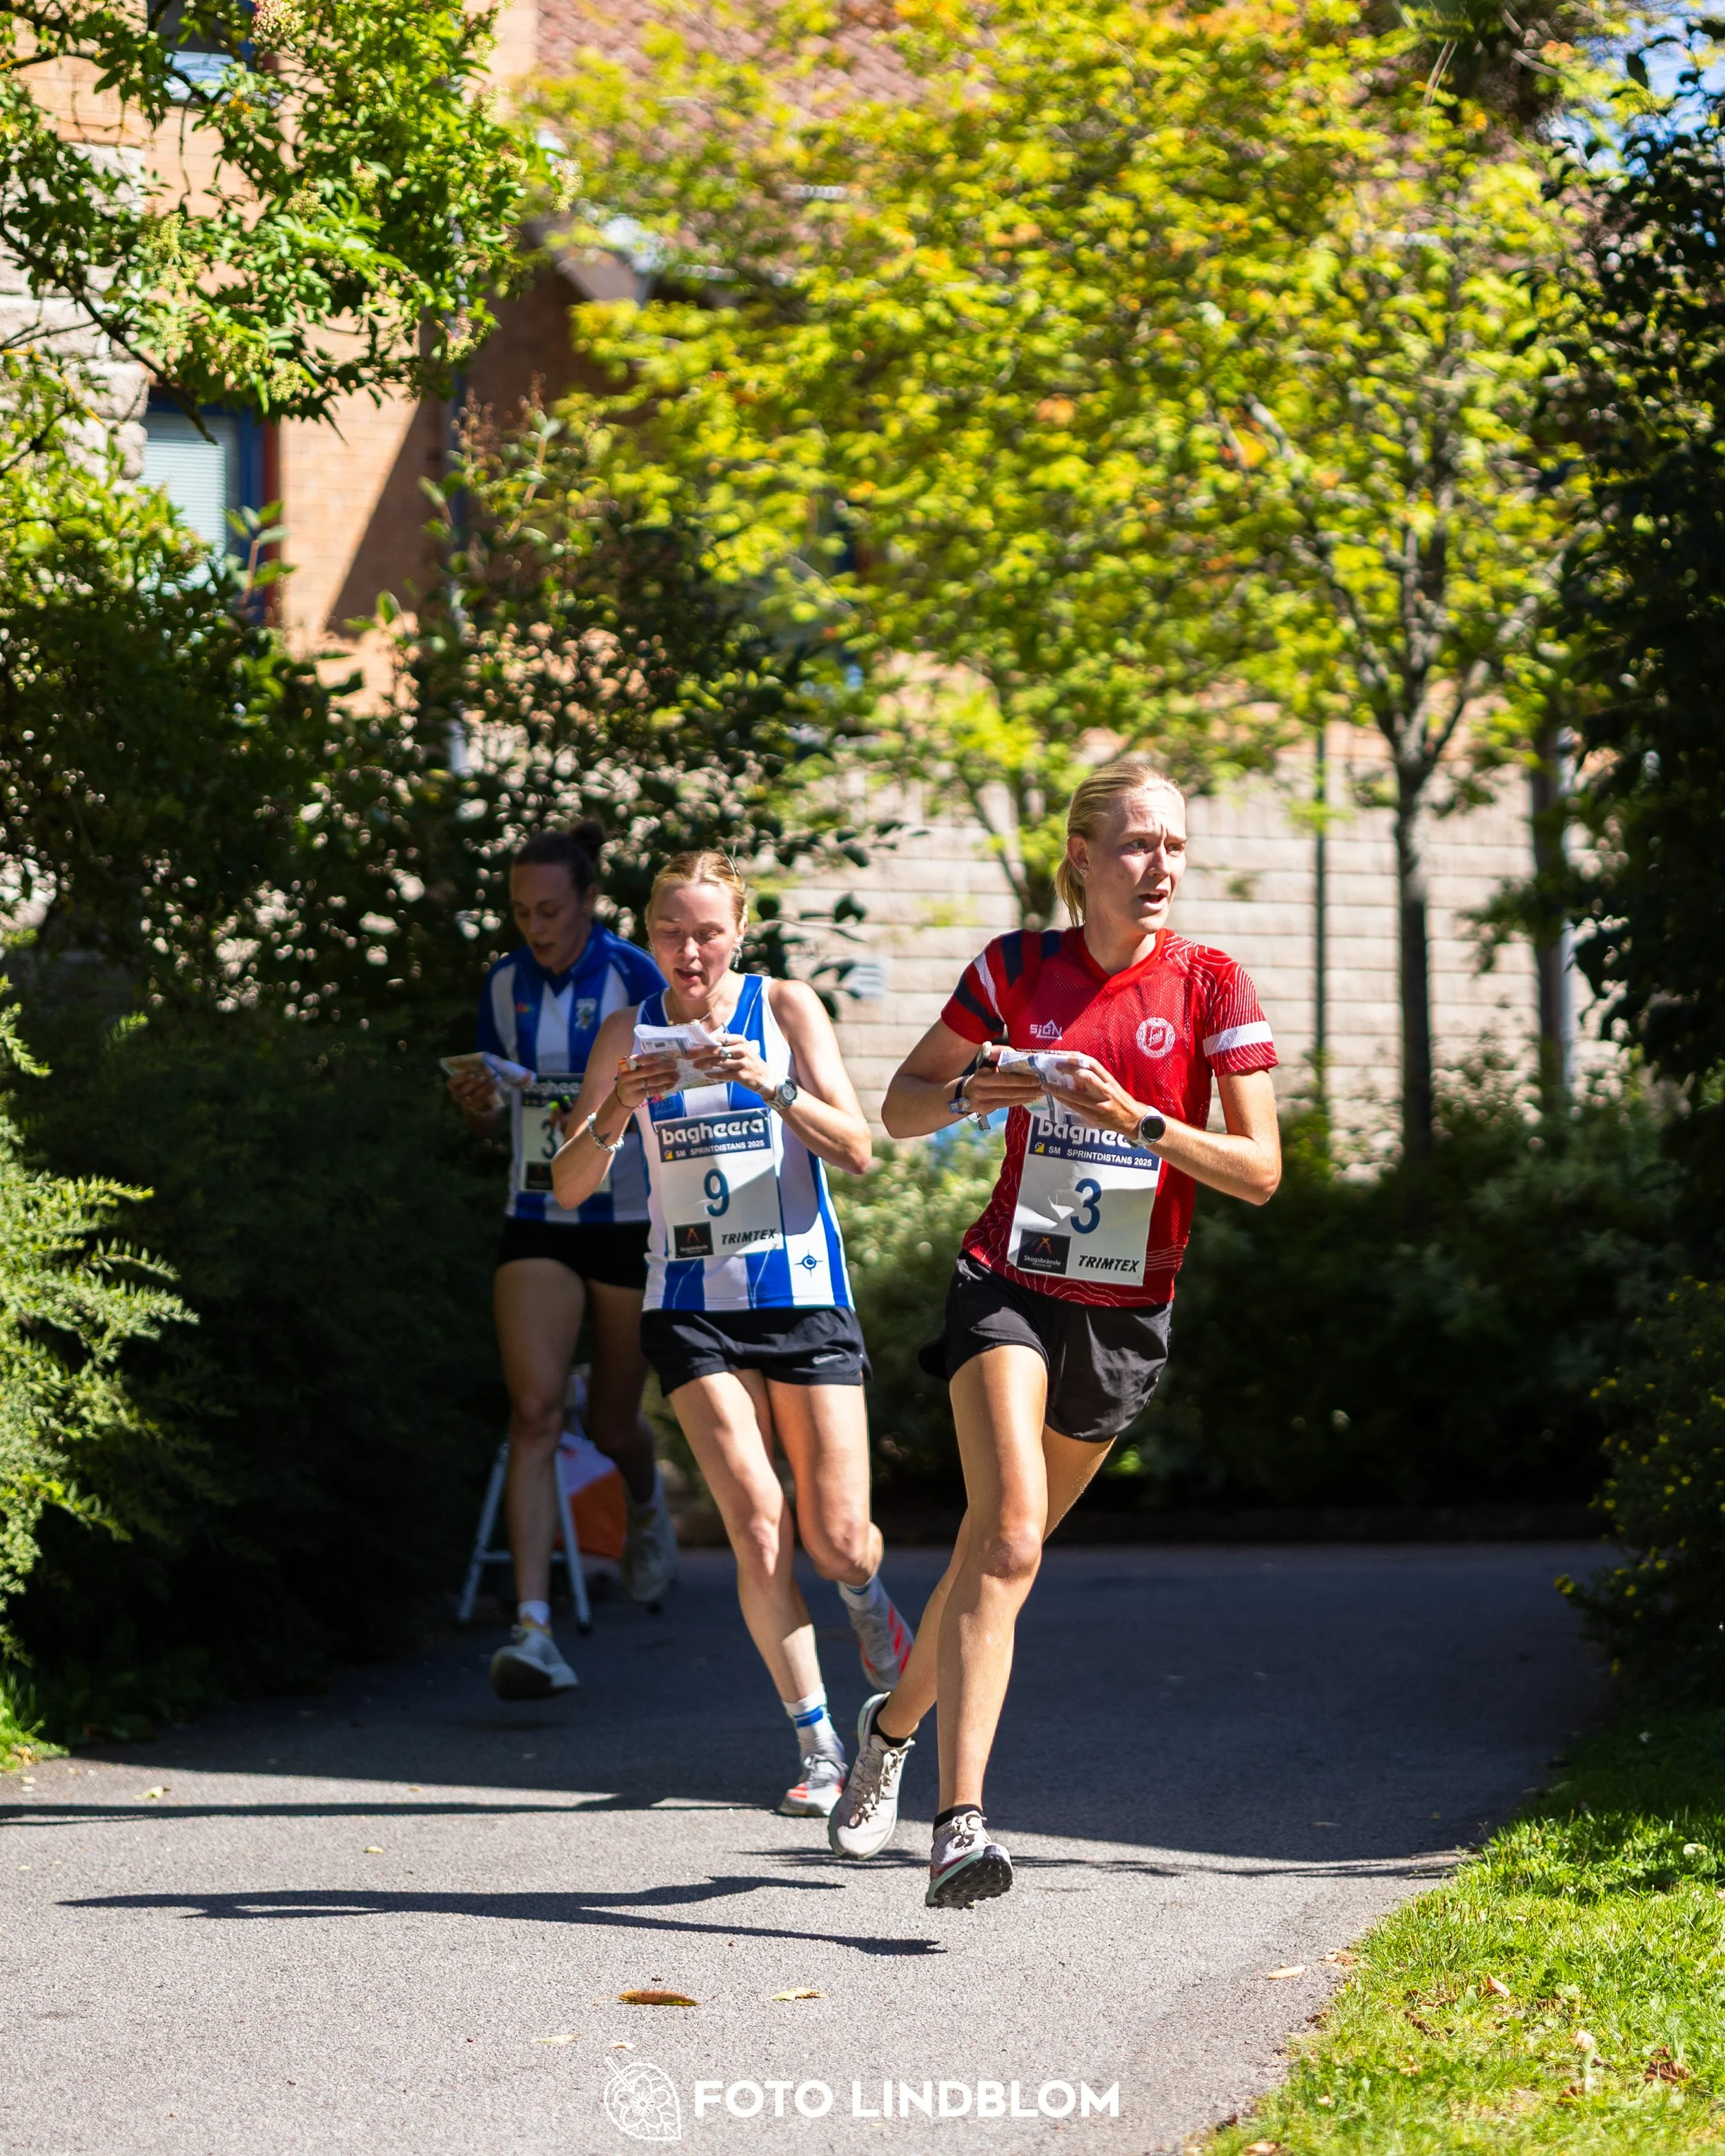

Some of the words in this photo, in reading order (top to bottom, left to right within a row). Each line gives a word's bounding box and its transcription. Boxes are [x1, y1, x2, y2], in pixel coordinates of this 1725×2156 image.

[662, 1118, 765, 1145] bagheera
[690, 1141, 746, 1156] SPRINTDISTANS
[747, 1140, 765, 1148] 2025
[1048, 1145, 1061, 1155] SM
[1067, 1148, 1132, 1165] SPRINTDISTANS
[1134, 1156, 1152, 1167] 2025
[704, 1168, 729, 1217] 9
[1070, 1178, 1102, 1234] 3
[721, 1228, 777, 1245] TRIMTEX
[1024, 1254, 1061, 1267] Skogsbränsle
[1078, 1254, 1140, 1273] TRIMTEX
